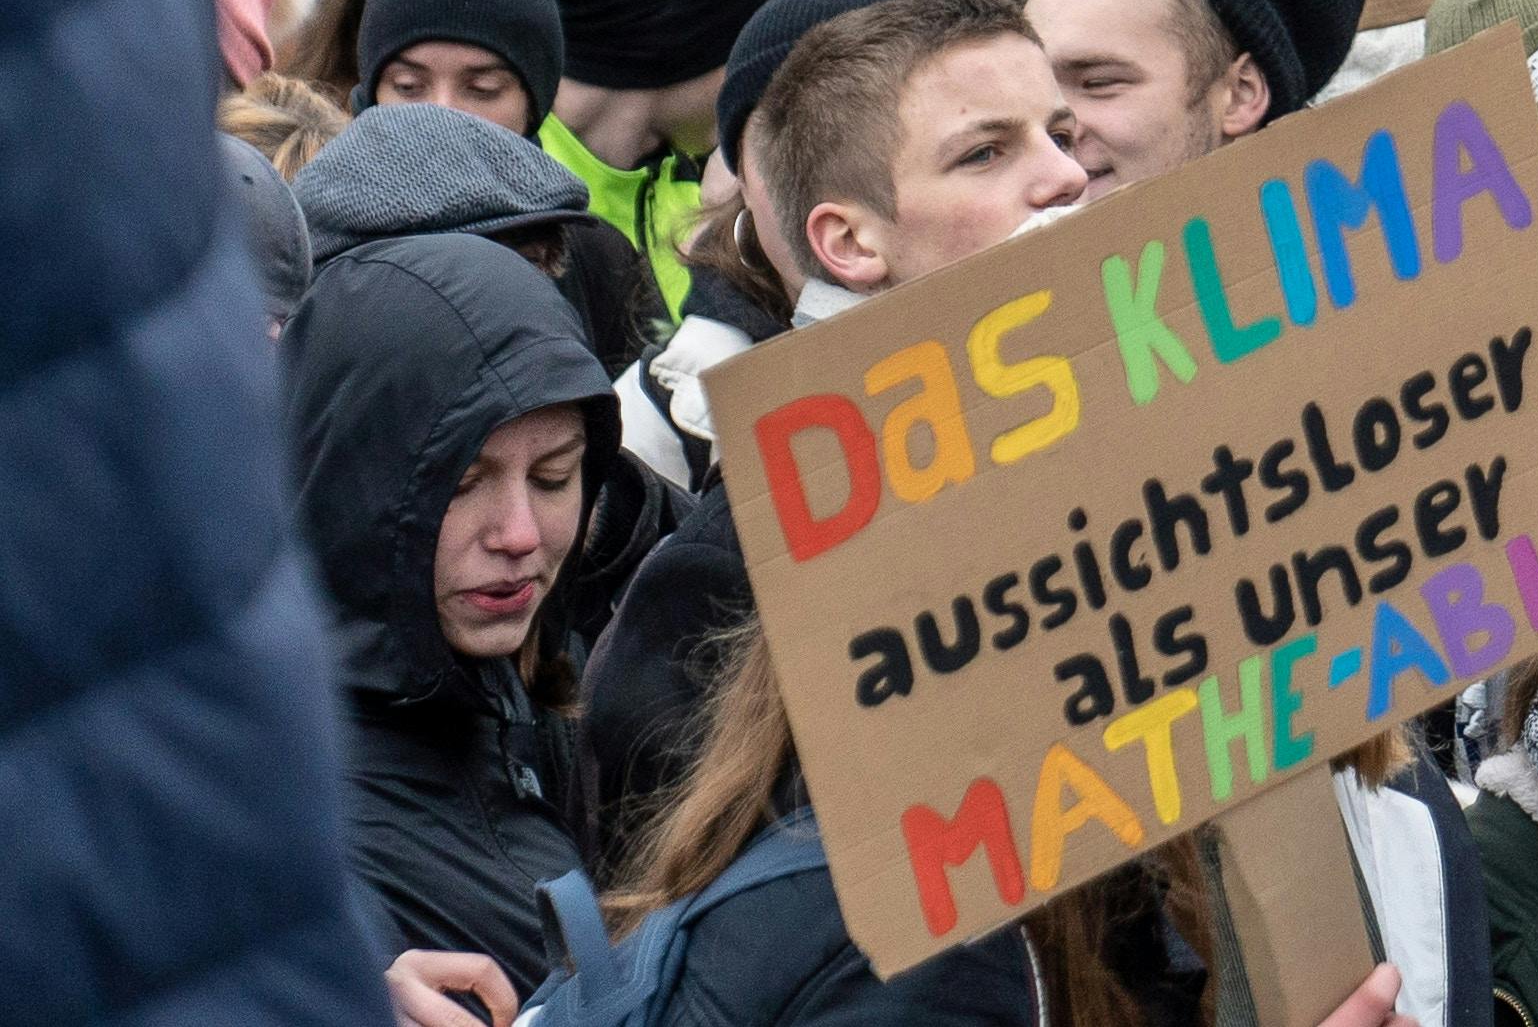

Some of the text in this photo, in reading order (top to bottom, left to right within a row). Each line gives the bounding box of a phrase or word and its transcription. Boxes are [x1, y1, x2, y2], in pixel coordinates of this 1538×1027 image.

[1100, 98, 1534, 406] KLIMA
[1052, 455, 1508, 728] als unser
